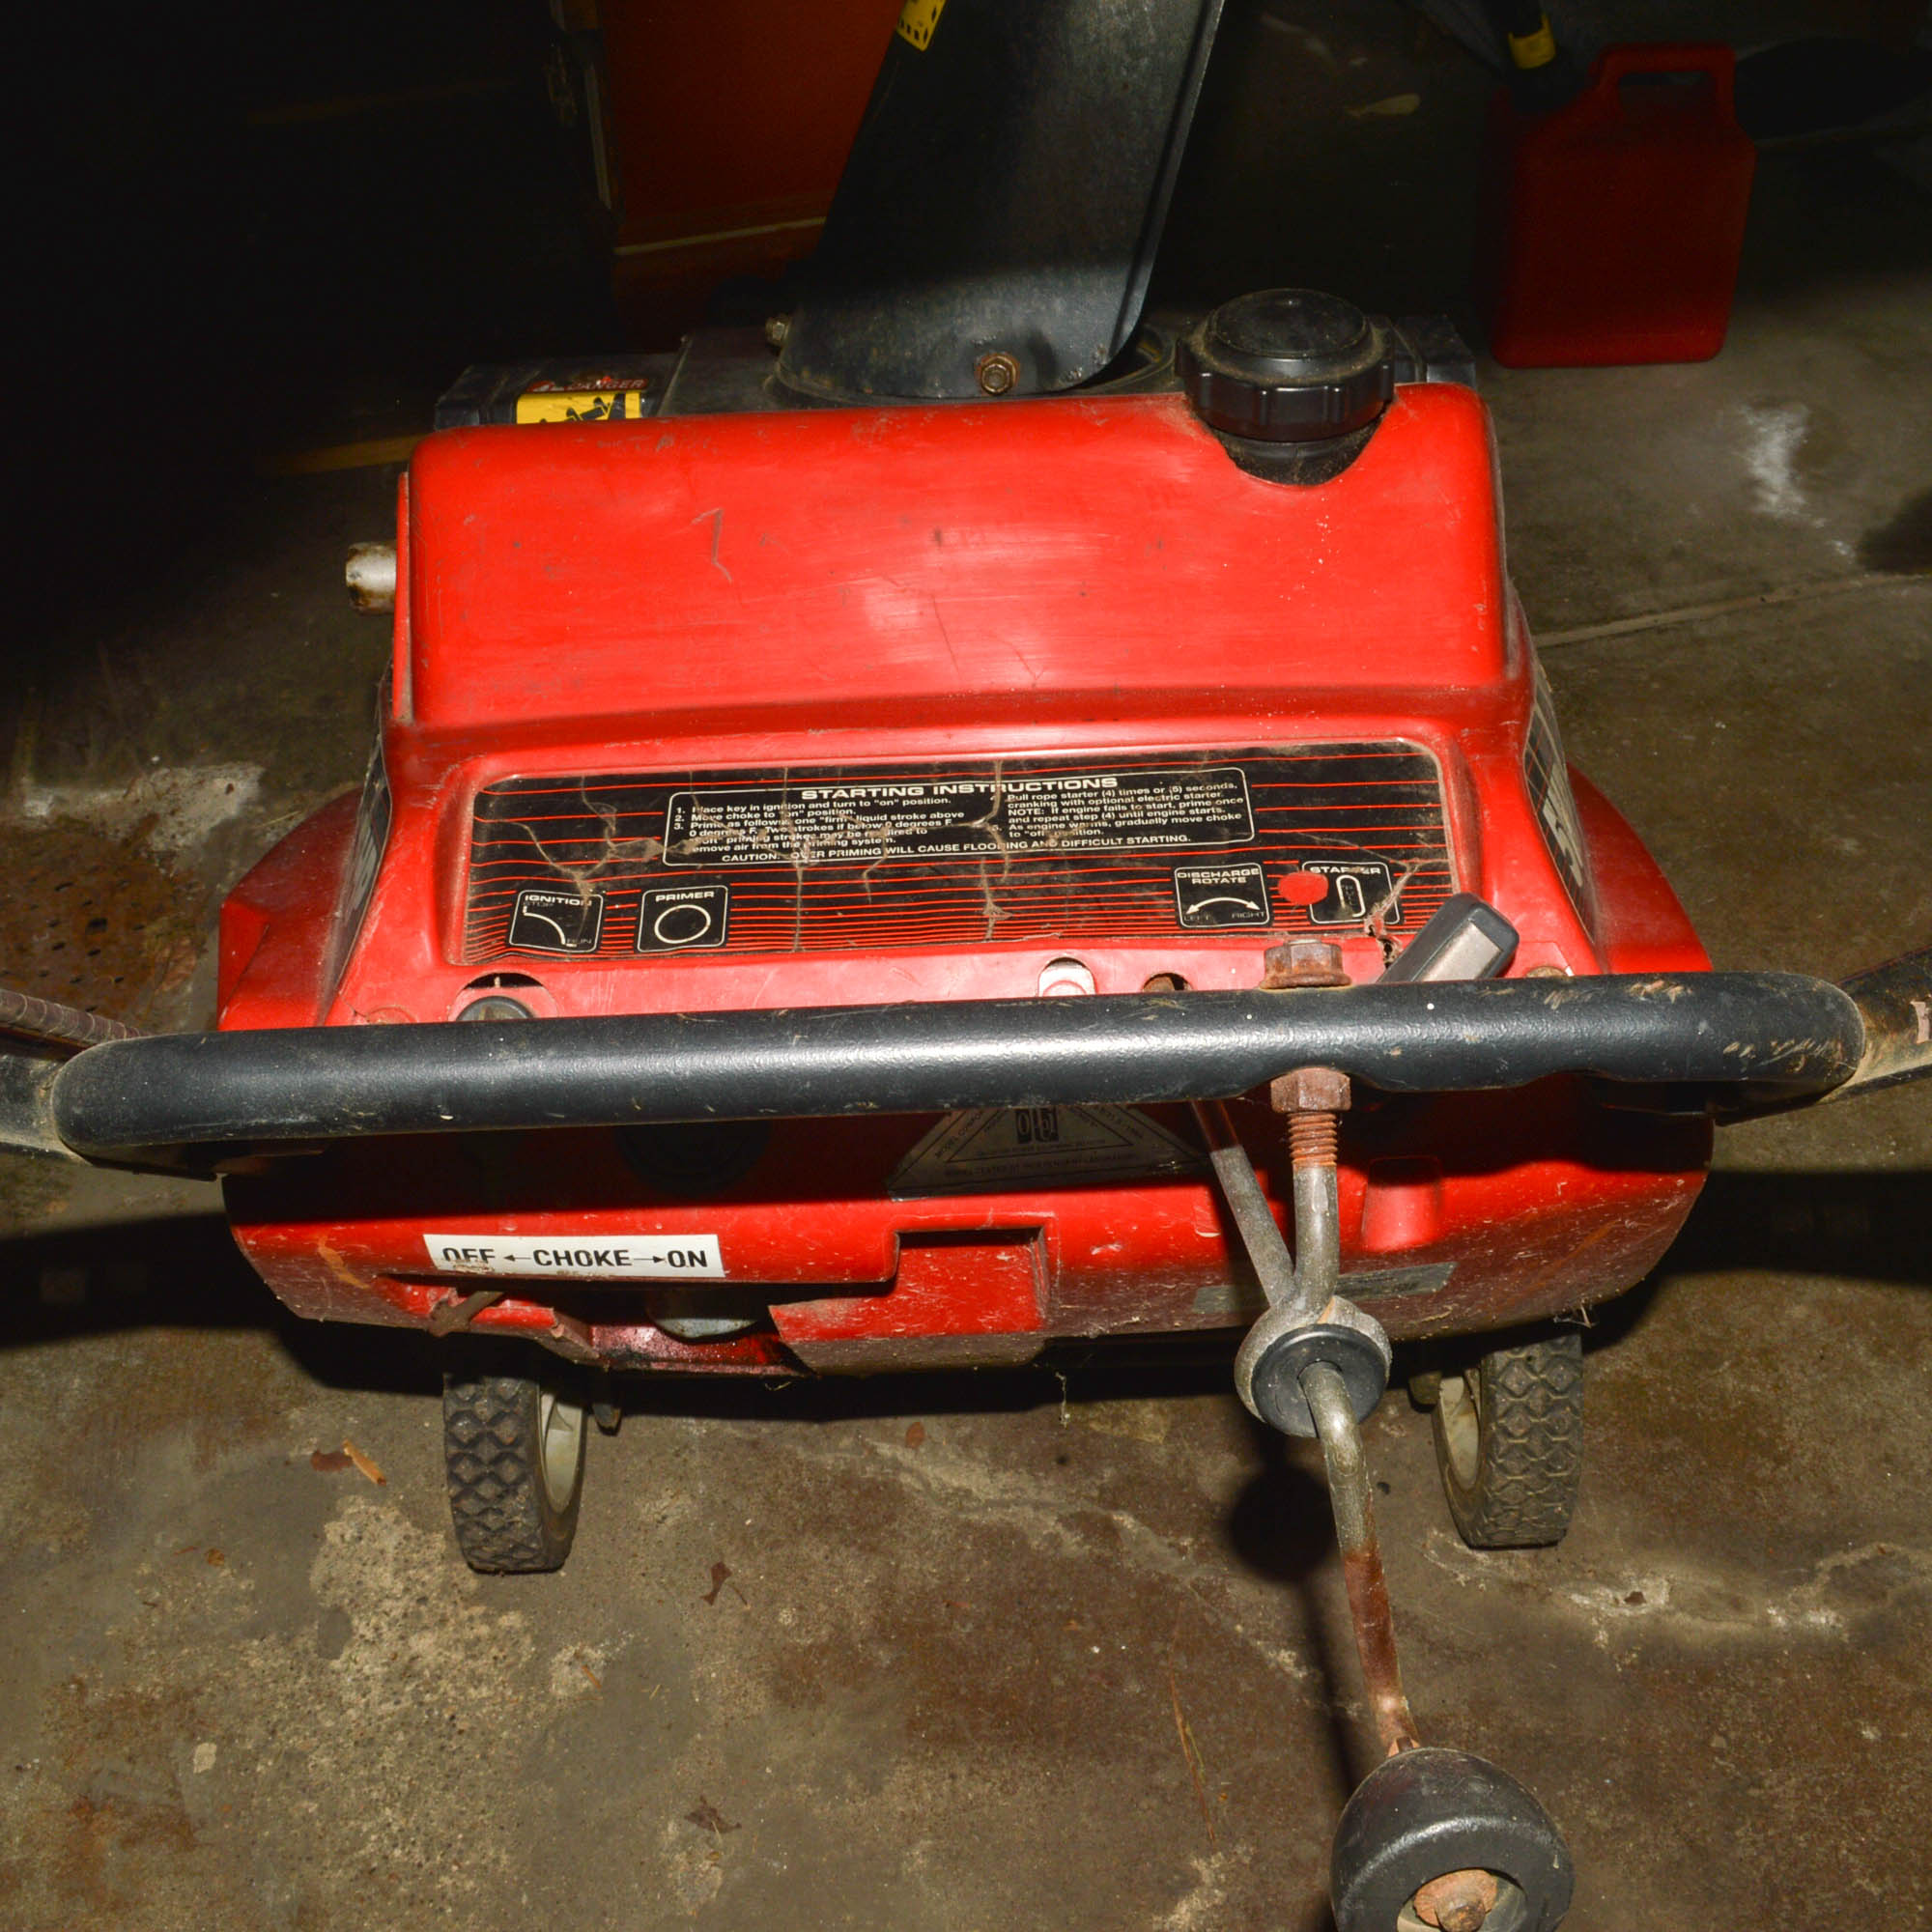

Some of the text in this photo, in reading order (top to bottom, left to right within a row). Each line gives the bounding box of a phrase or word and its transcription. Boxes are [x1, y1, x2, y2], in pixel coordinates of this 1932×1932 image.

[568, 380, 645, 391] DANGER
[802, 778, 1119, 800] STARTING INSTRUCTIONS
[1031, 793, 1058, 803] rope
[1061, 791, 1097, 800] starter
[1101, 790, 1116, 799] (4)
[1119, 787, 1151, 796] times
[726, 805, 748, 813] key
[762, 803, 806, 813] ignion
[902, 797, 952, 807] position.
[1008, 801, 1058, 810] cranking
[1088, 796, 1134, 806] optional
[1137, 794, 1180, 803] electric
[1008, 809, 1044, 817] NOTE:
[1062, 806, 1100, 815] engine
[1103, 804, 1127, 812] fails
[1179, 799, 1211, 810] prime
[1214, 797, 1243, 806] once
[691, 821, 724, 830] Prime
[856, 813, 887, 823] liquid
[890, 812, 927, 821] stroke
[929, 810, 965, 820] above
[725, 811, 761, 820] choke
[808, 809, 857, 818] position.
[1009, 823, 1024, 832] As
[1026, 821, 1065, 832] engine
[1114, 816, 1168, 829] gradually
[1171, 815, 1203, 824] move
[1206, 812, 1242, 822] choke
[1032, 814, 1070, 824] repeat
[1073, 812, 1098, 822] step
[1101, 811, 1116, 820] (4)
[1119, 810, 1144, 818] until
[1147, 809, 1186, 818] engine
[1188, 807, 1226, 815] starts.
[764, 825, 789, 834] Two
[793, 824, 834, 834] strokes
[847, 820, 882, 831] below
[895, 819, 943, 830] degrees
[726, 836, 770, 845] primig
[819, 831, 844, 840] my
[846, 830, 862, 838] be
[865, 828, 914, 839] ruired
[781, 840, 801, 849] the
[804, 839, 849, 850] rimng
[790, 850, 825, 861] OVER
[828, 847, 882, 858] PRIMING
[886, 845, 915, 855] WILL
[917, 843, 960, 853] CAUSE
[1031, 840, 1059, 849] AND
[1063, 838, 1123, 848] DIFFICULT
[1126, 835, 1191, 845] STARTING.
[1177, 867, 1260, 879] DISCHARGE
[1310, 866, 1382, 875] STARER
[1191, 876, 1248, 885] ROTATE
[525, 895, 593, 908] IGNITION
[655, 890, 716, 903] PRIMER
[442, 1247, 708, 1268] OFF CHOKE ON
